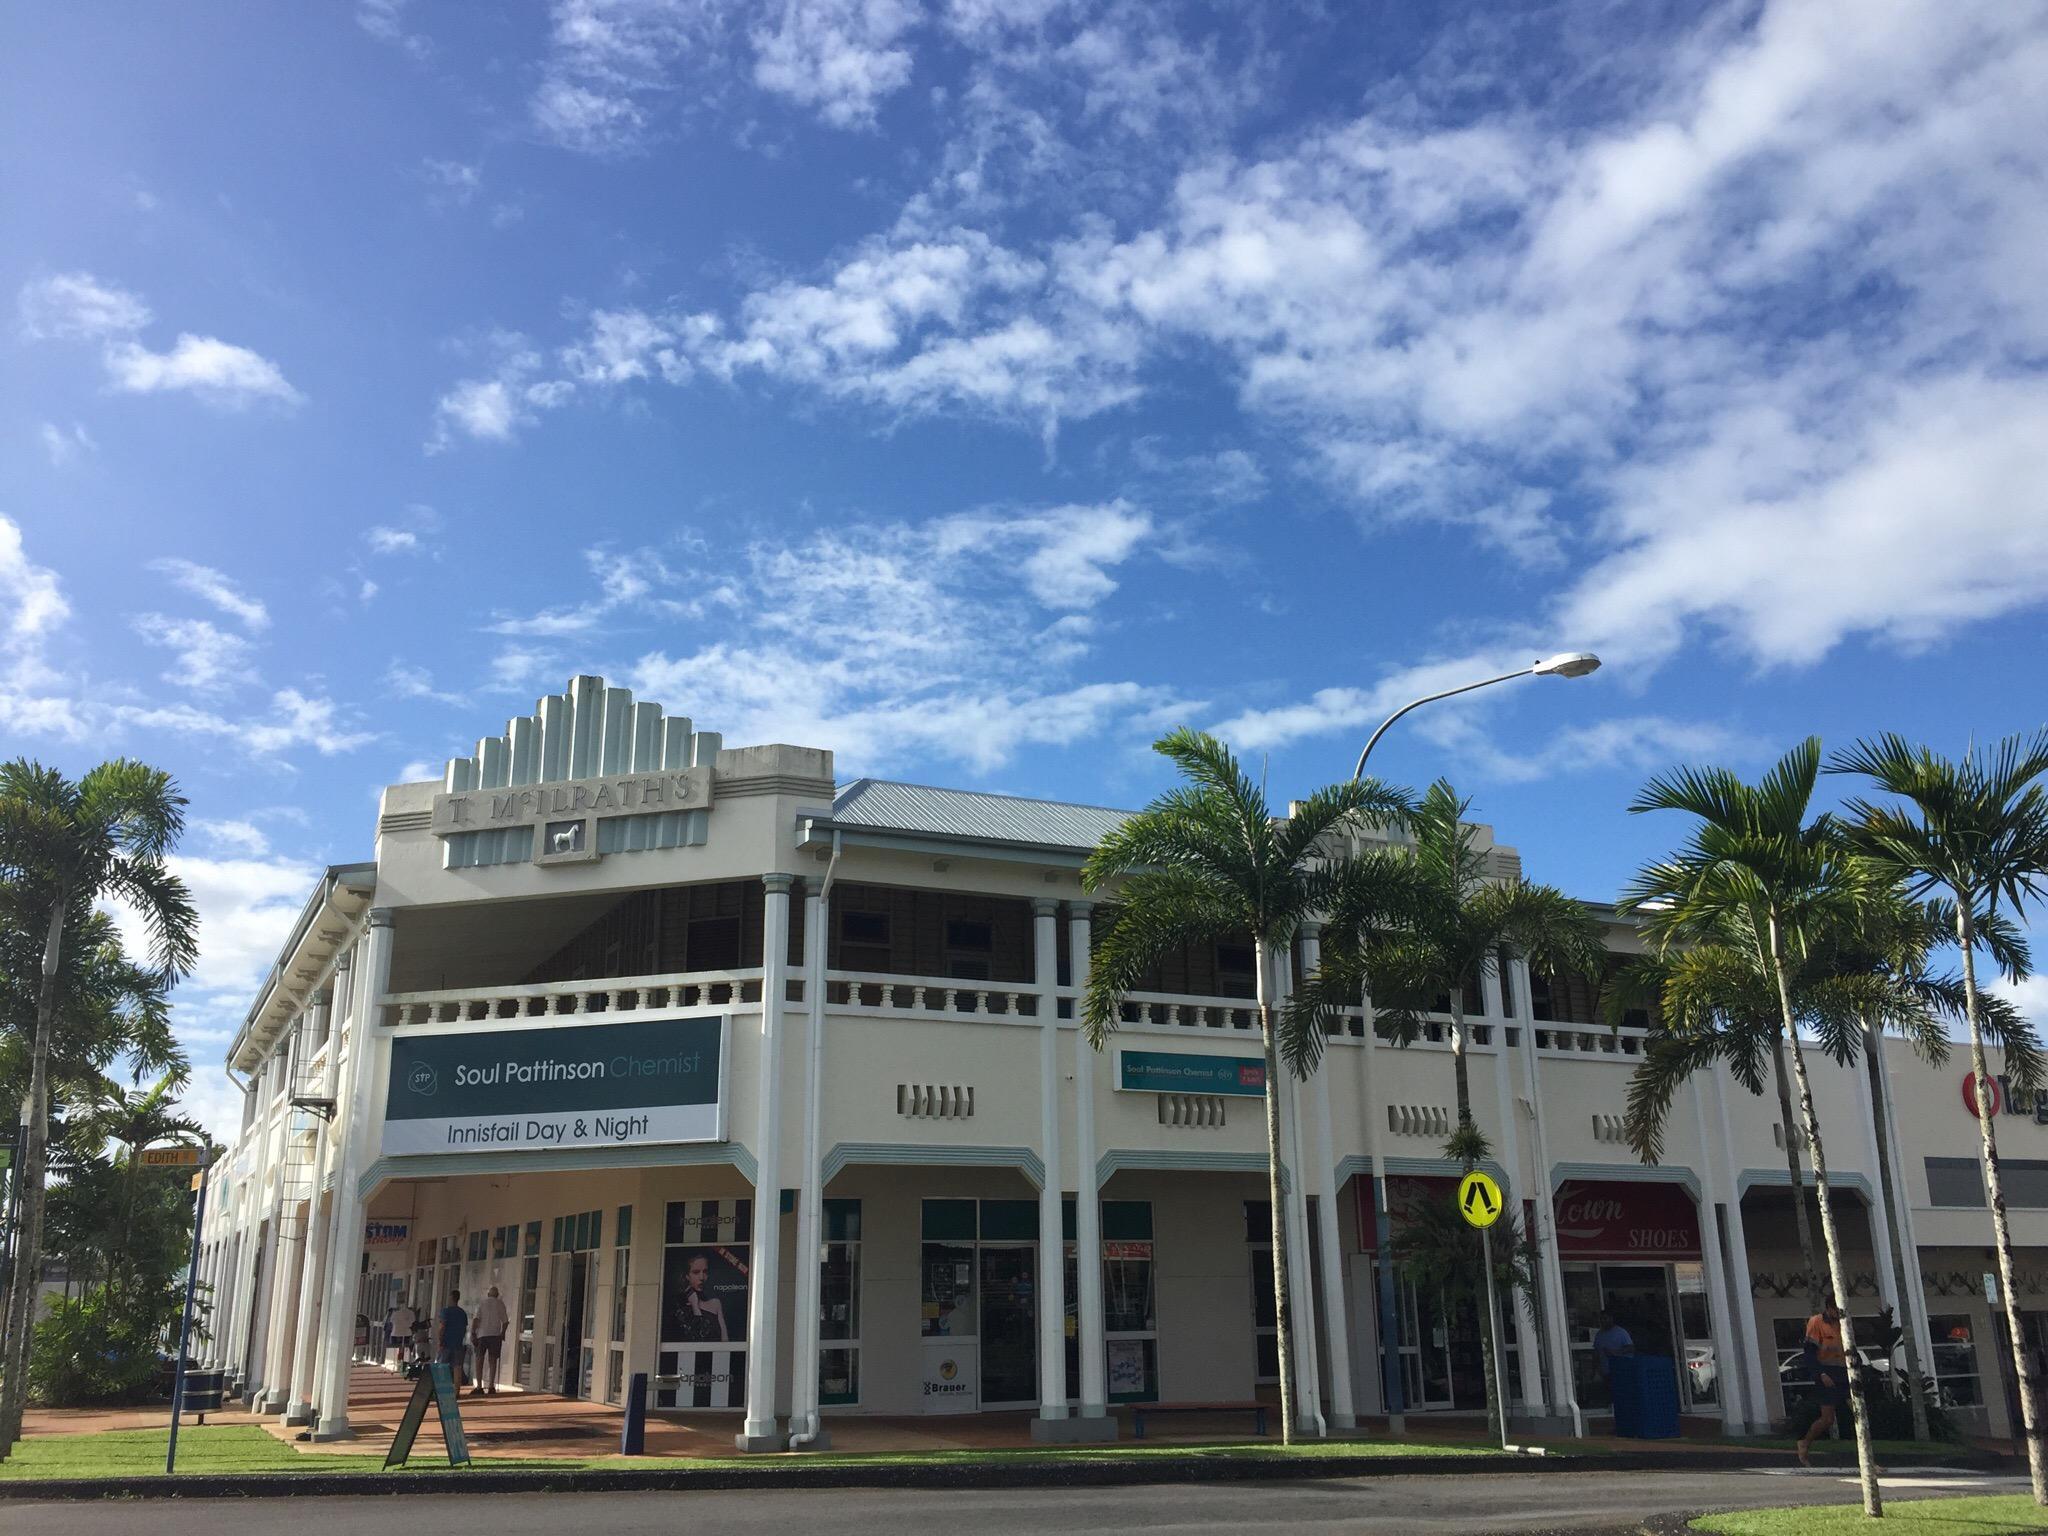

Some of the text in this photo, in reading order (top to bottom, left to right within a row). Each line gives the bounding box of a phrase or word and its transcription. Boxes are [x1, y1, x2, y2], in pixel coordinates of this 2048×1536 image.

[454, 1052, 701, 1087] Soul Pattinson Chemist
[447, 1114, 649, 1144] Innisfail Day & Night
[147, 1151, 179, 1164] EDITH
[1628, 1228, 1690, 1249] SHOES
[679, 1371, 734, 1386] apoleon
